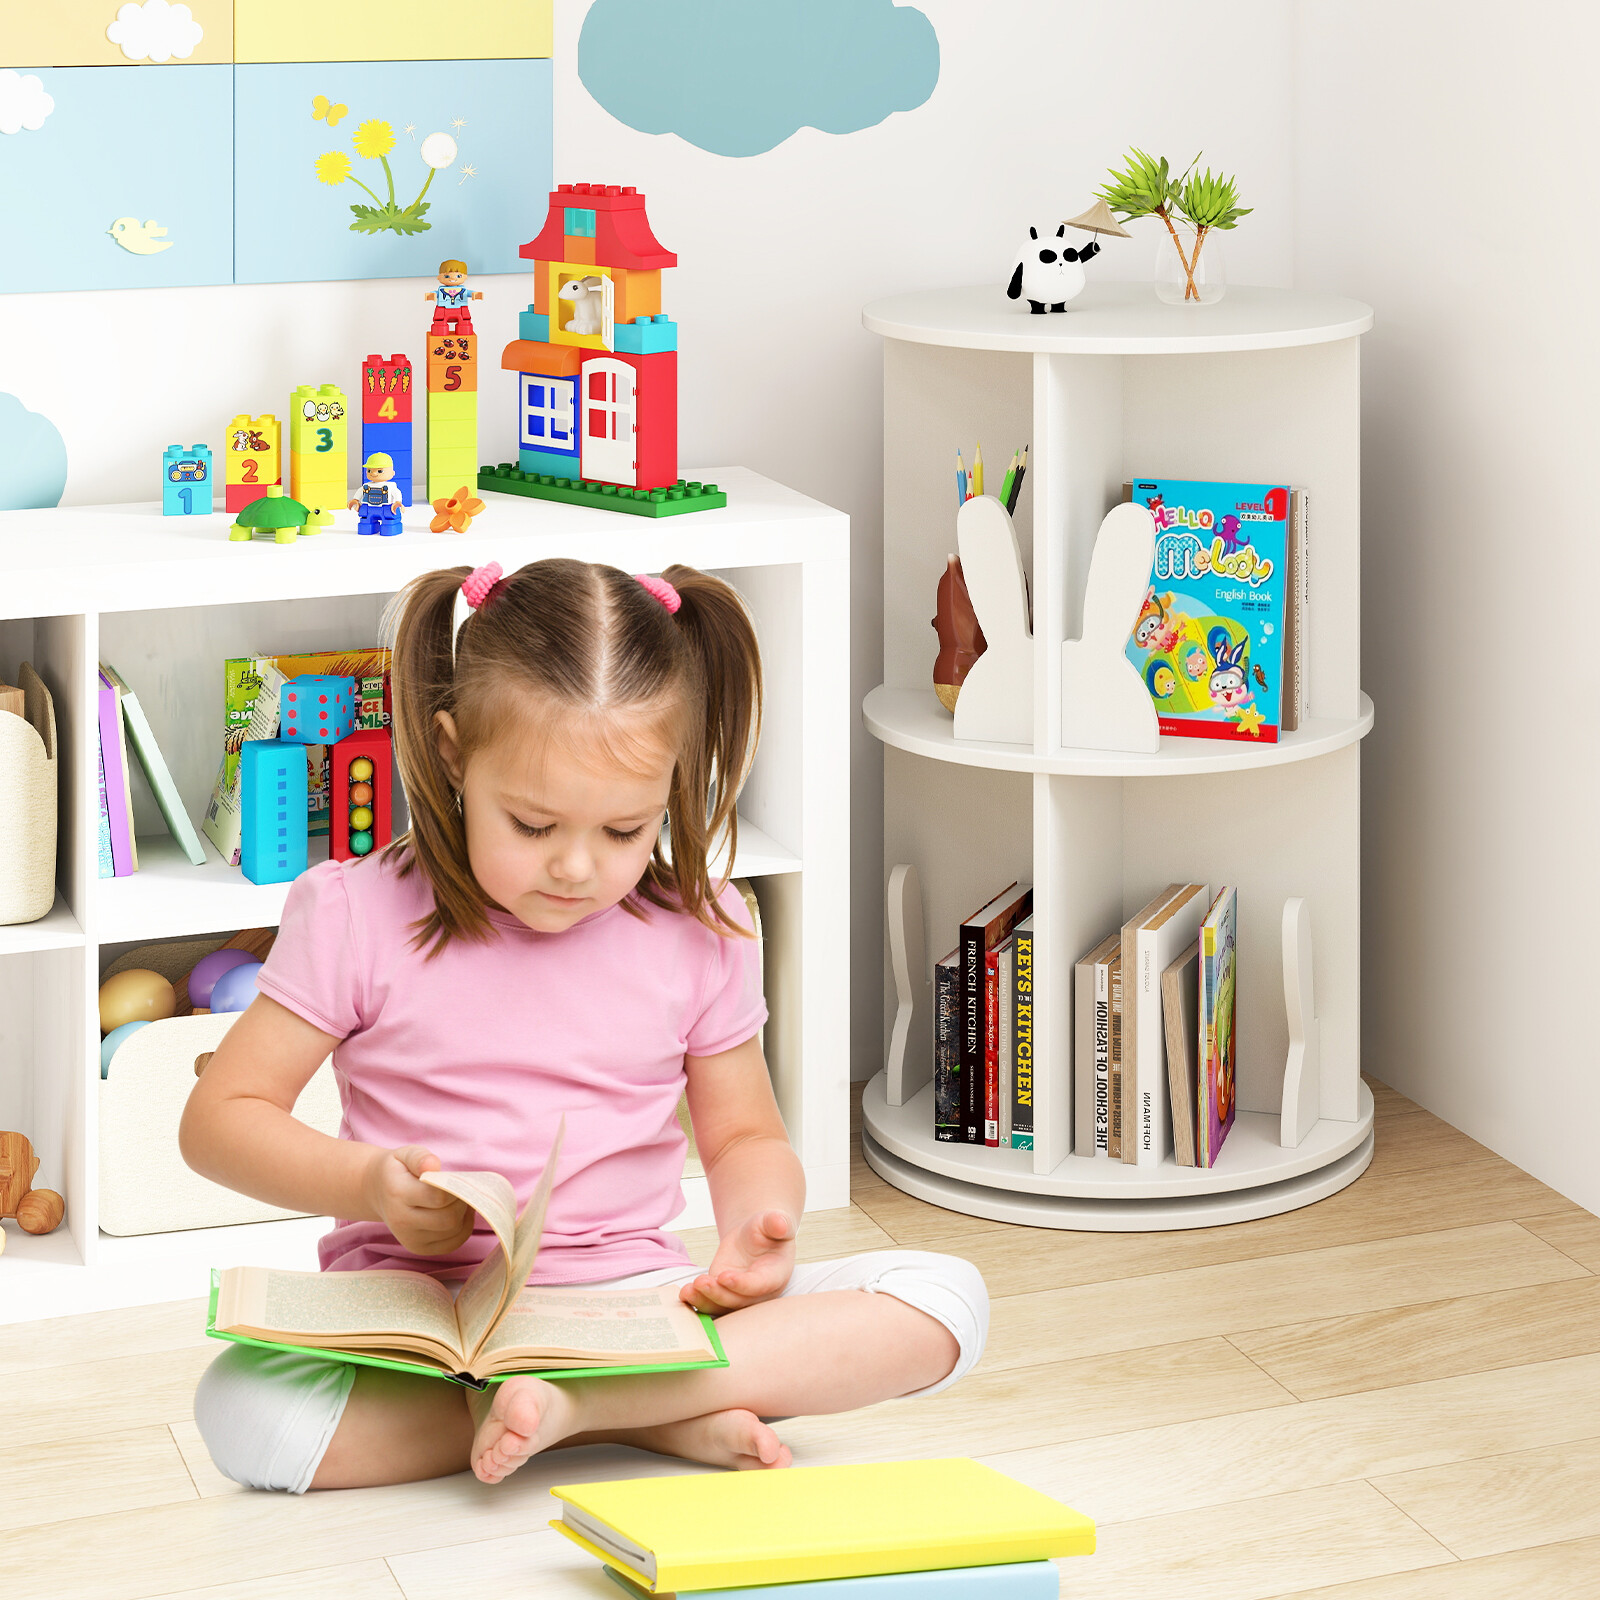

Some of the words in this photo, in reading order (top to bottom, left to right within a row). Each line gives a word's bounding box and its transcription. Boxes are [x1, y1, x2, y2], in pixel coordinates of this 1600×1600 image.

[444, 365, 462, 391] 5
[378, 396, 398, 420] 4
[315, 428, 334, 453] 3
[241, 458, 259, 483] 2
[177, 487, 193, 515] 1
[1235, 502, 1264, 511] LEVEL
[1266, 498, 1274, 512] 1
[1150, 506, 1213, 533] HELLO
[1215, 588, 1247, 602] English
[1249, 590, 1273, 602] Book
[967, 940, 977, 992] FRENCH
[1017, 938, 1032, 993] KEYS
[939, 981, 951, 995] The
[939, 1016, 951, 1041] Kitchen
[967, 996, 977, 1055] KITCHEN
[1017, 1003, 1032, 1107] KITCHEN
